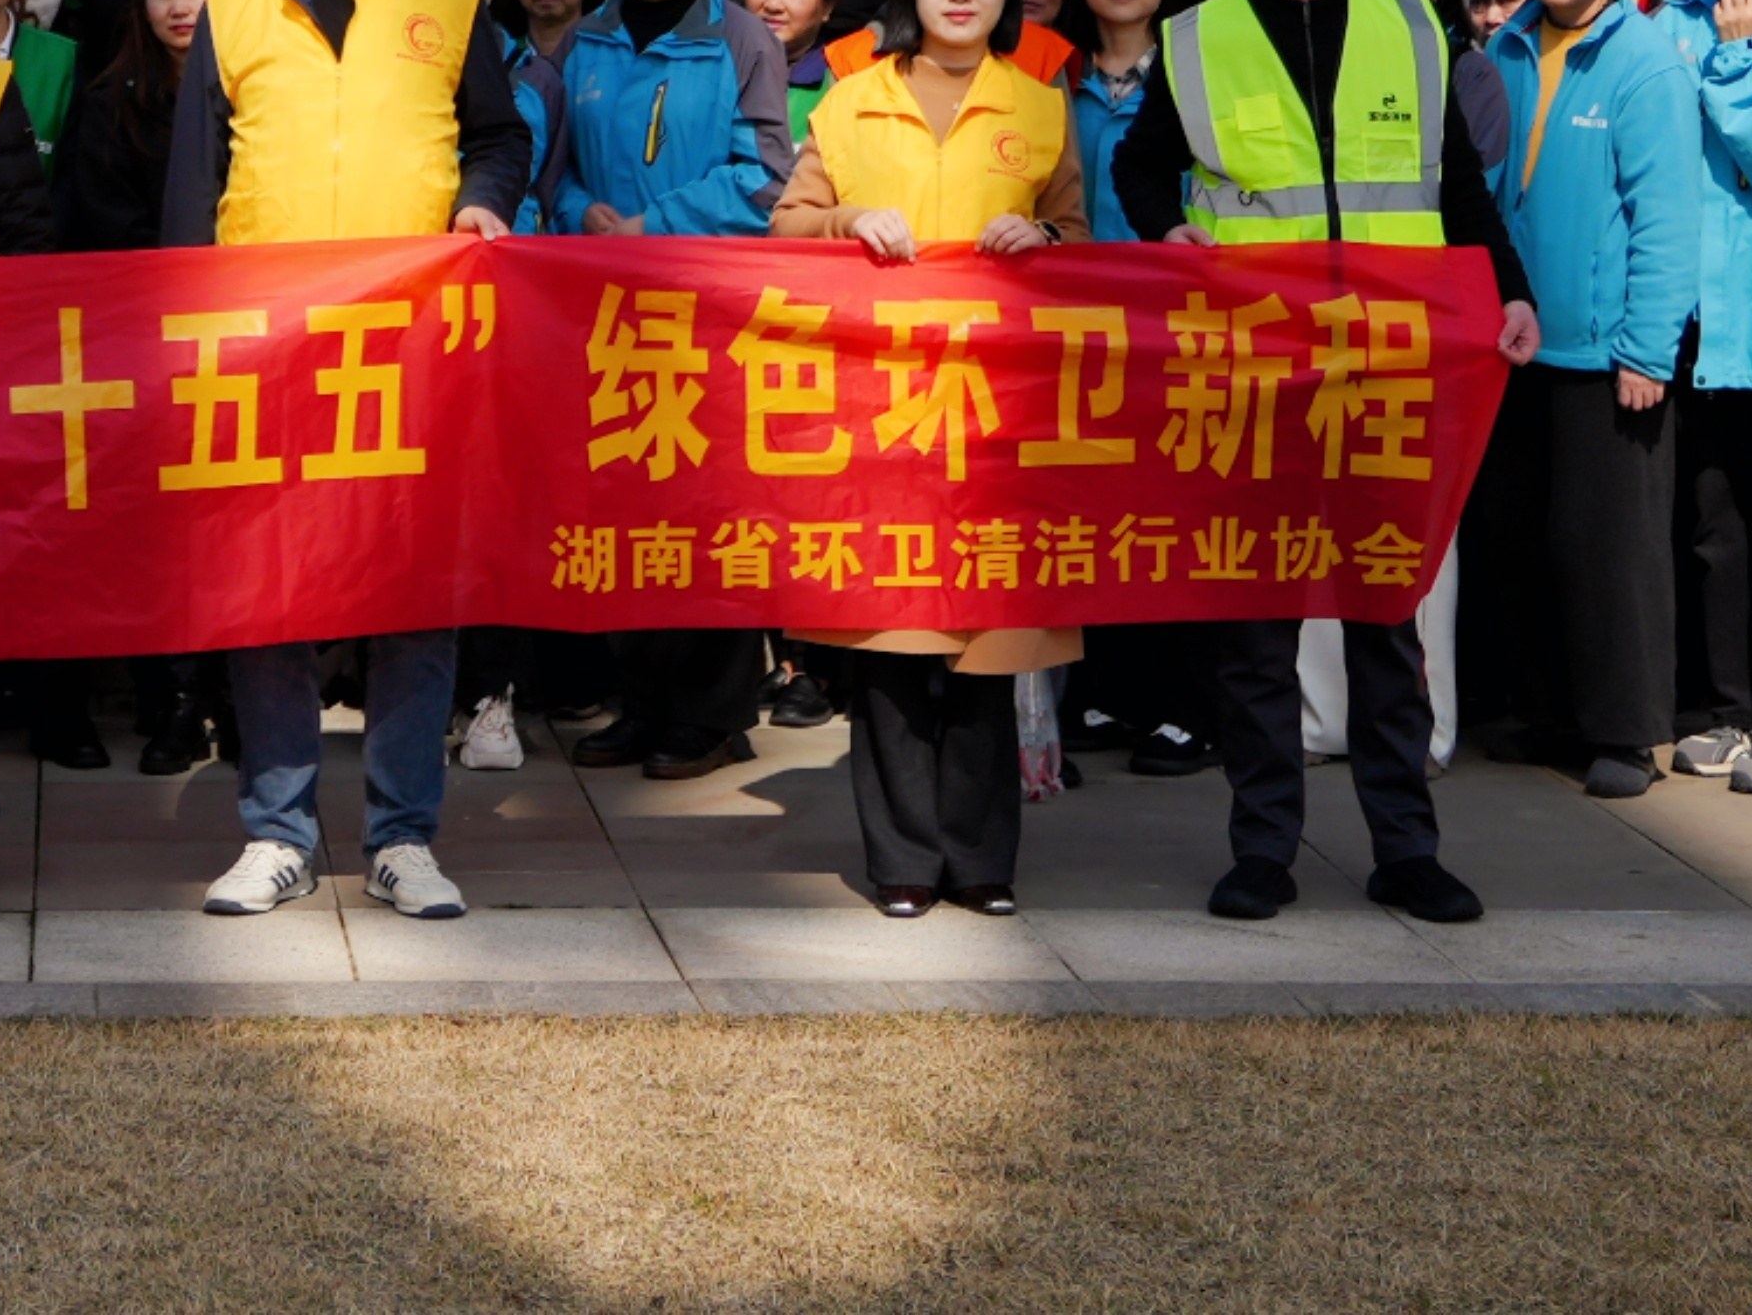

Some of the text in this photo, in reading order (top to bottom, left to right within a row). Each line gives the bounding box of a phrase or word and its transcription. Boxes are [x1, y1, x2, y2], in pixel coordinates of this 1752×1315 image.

[549, 512, 1425, 590] 湖南省环卫清洁行业协会
